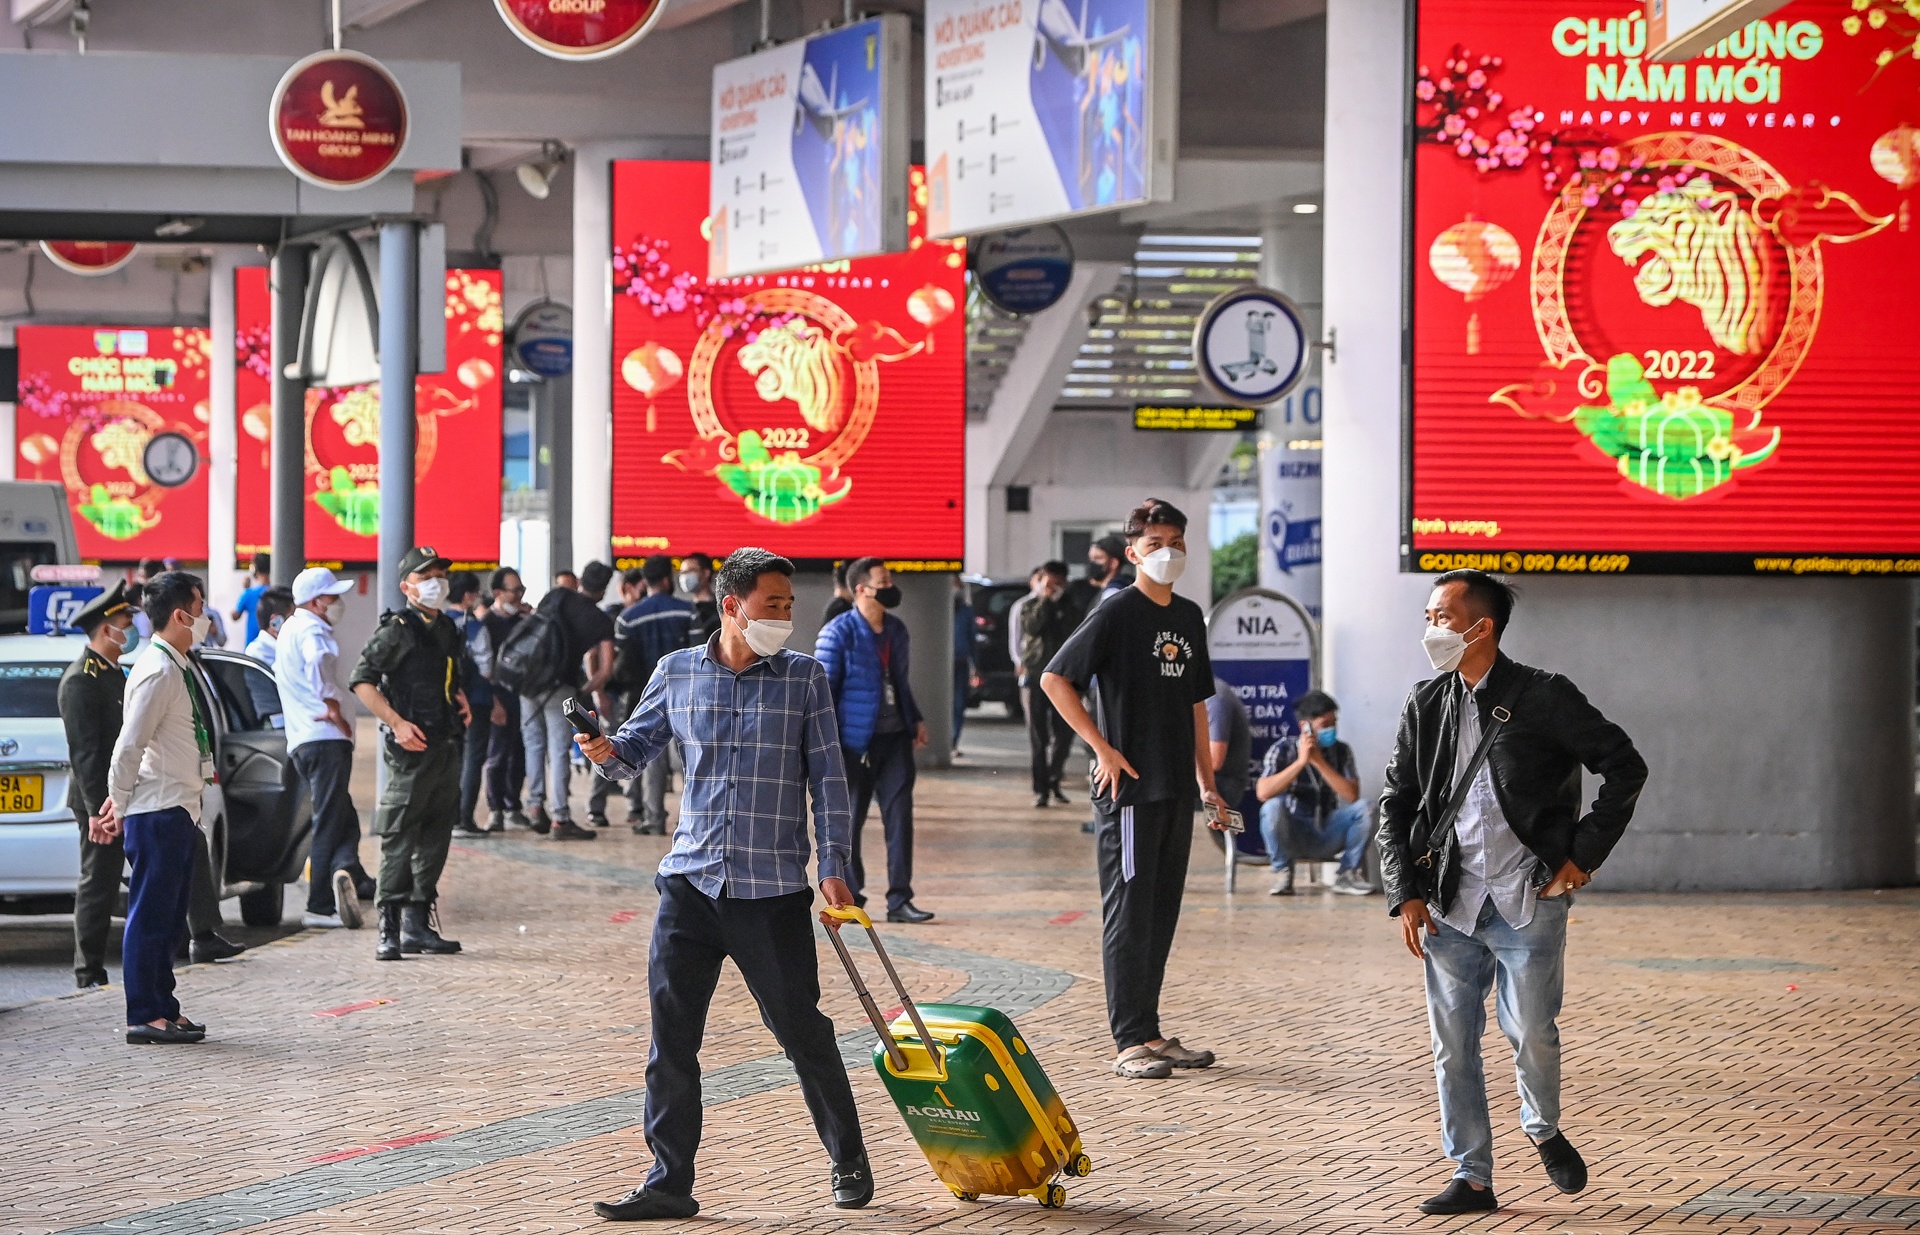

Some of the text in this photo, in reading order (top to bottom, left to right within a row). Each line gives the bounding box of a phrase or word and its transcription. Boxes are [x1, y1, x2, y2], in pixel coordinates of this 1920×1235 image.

[548, 0, 606, 14] GROUP
[1585, 57, 1781, 104] NĂM MỚI
[1559, 110, 1817, 128] HAPPY NEW YEAR
[318, 143, 363, 157] GROUP
[1642, 349, 1716, 380] 2022
[761, 427, 810, 449] 2022
[1418, 553, 1631, 572] GOLDSUN 090 464 6699
[1237, 616, 1279, 635] NIA
[905, 1104, 981, 1122] ACHAU
